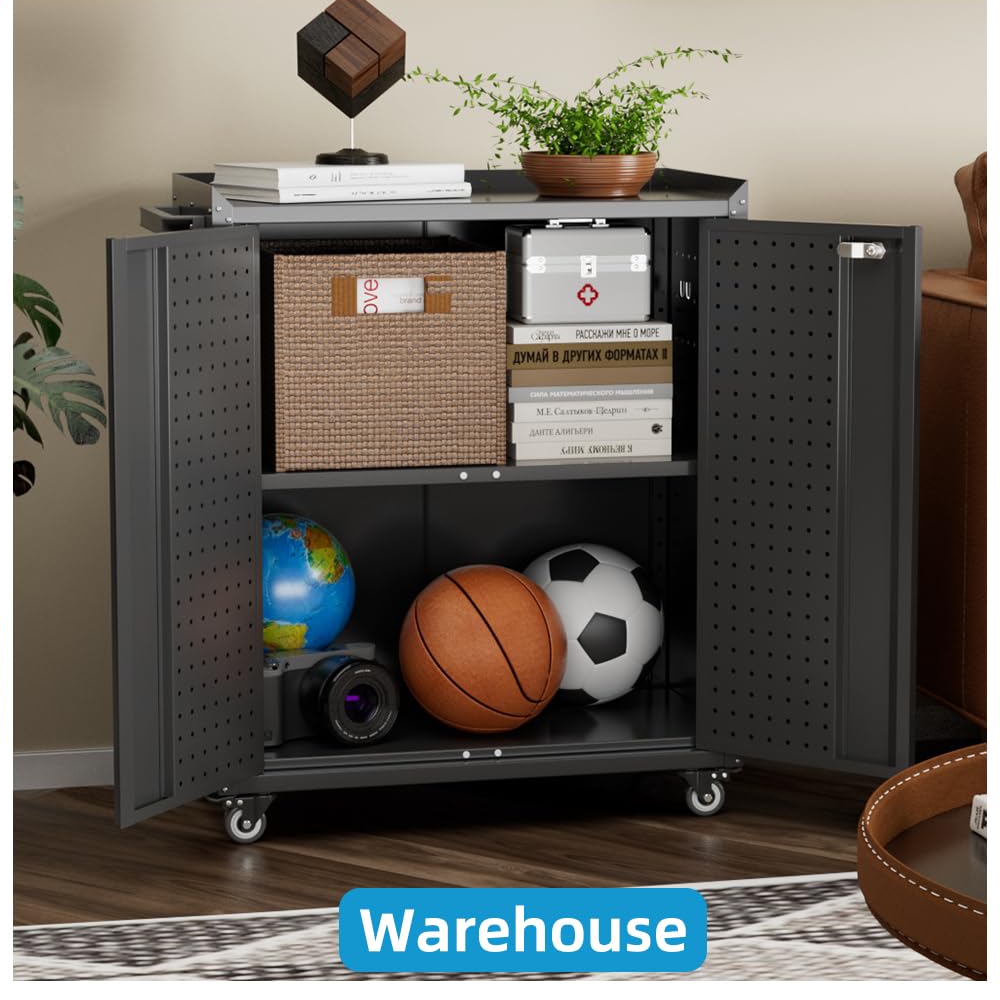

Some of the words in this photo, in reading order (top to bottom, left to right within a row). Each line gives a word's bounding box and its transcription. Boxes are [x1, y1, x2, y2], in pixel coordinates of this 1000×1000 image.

[399, 295, 422, 304] brand
[575, 328, 614, 340] РАССКАЖИ
[616, 328, 632, 339] МНЕ
[640, 327, 660, 338] МОРЕ
[513, 348, 549, 365] ДУМАЙ
[552, 350, 559, 363] В
[562, 348, 602, 363] ДРУГИХ
[604, 348, 659, 361] ФОРМАТАХ
[529, 428, 554, 437] ДАНТЕ
[555, 427, 594, 436] АЛИГЬЕРИ
